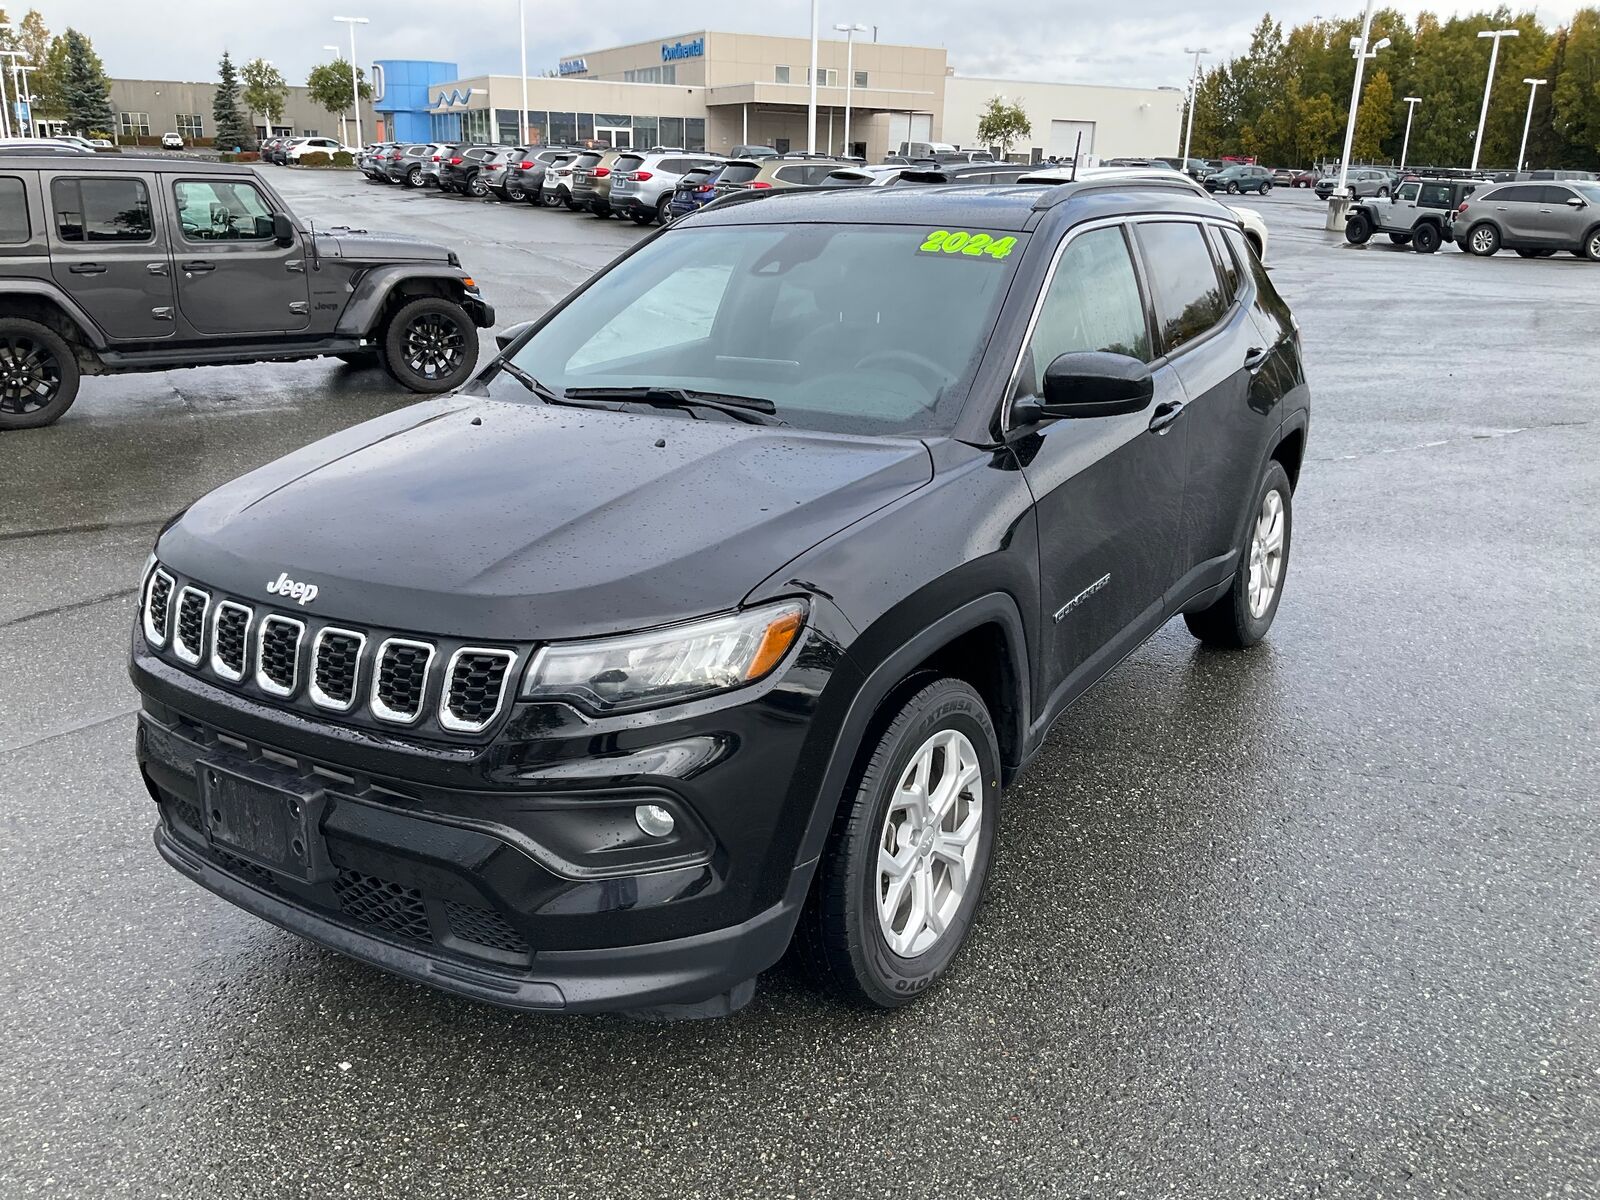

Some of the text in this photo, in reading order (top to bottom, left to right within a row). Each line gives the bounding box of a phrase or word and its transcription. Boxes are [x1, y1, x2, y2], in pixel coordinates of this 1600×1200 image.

[662, 37, 704, 61] Continental
[920, 230, 1018, 259] 2024
[266, 572, 319, 606] Jeep
